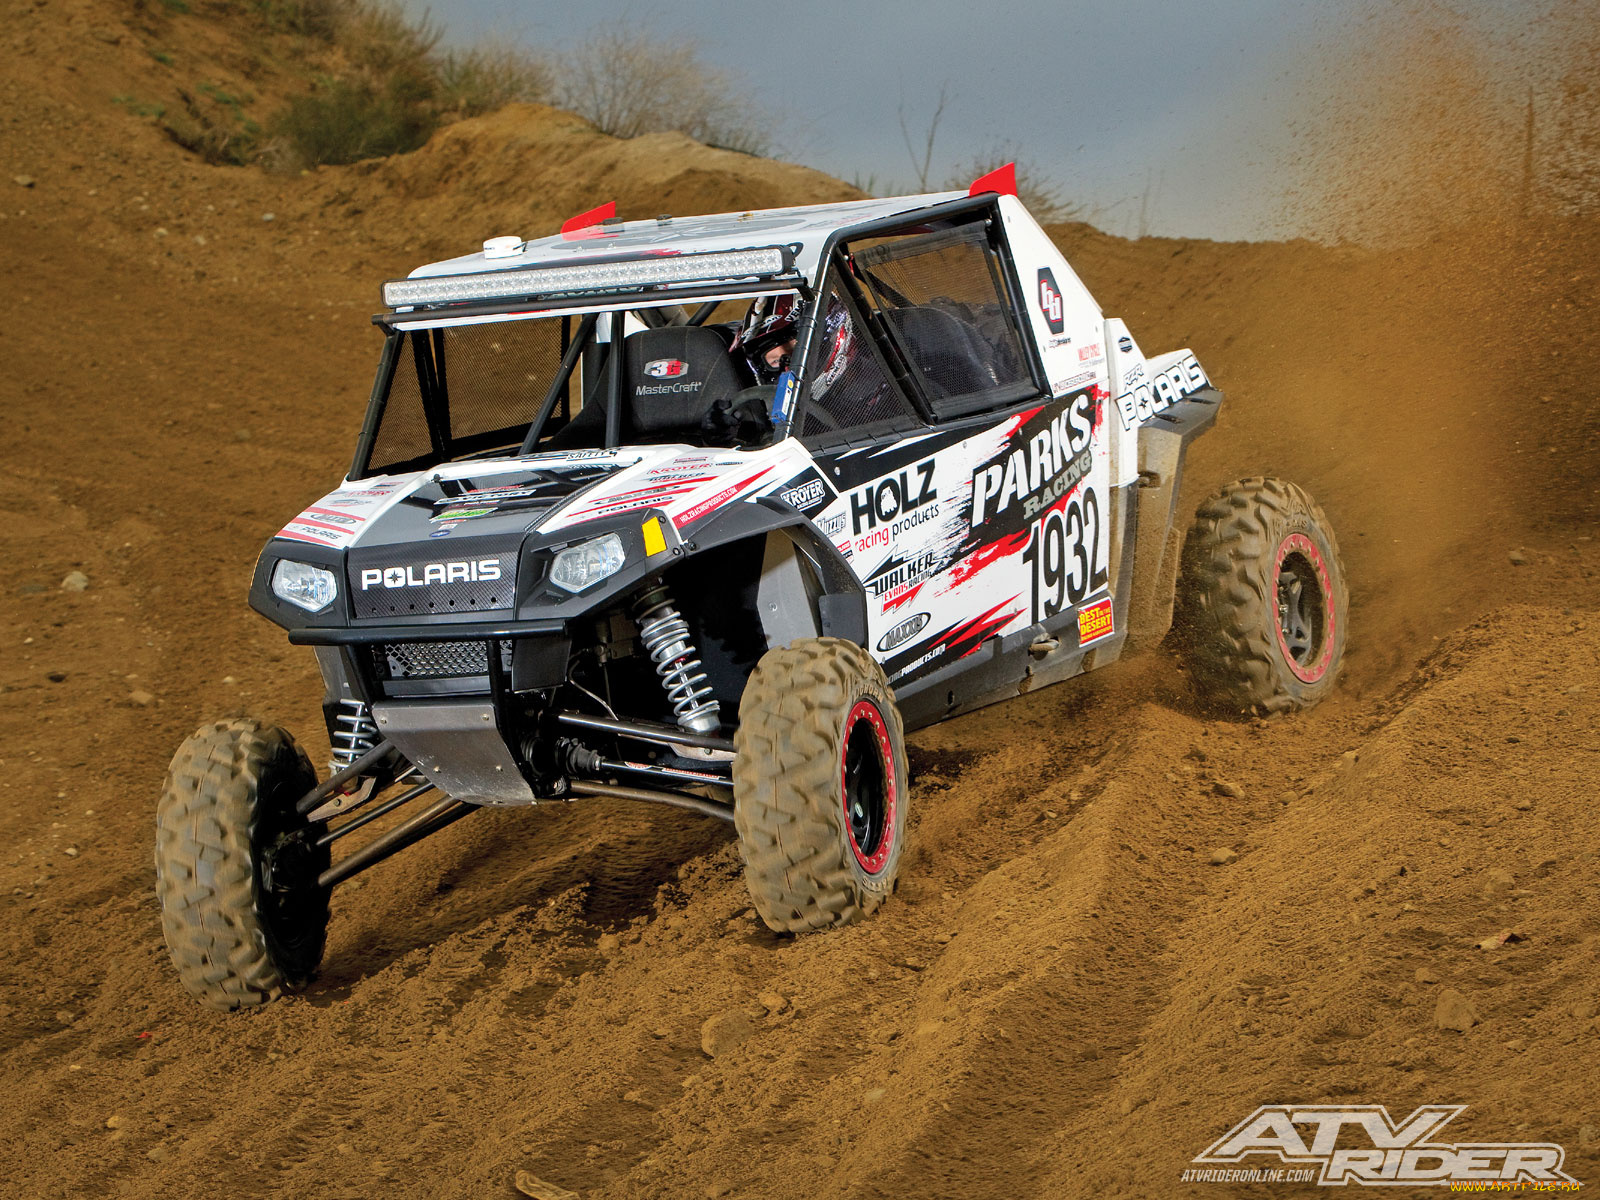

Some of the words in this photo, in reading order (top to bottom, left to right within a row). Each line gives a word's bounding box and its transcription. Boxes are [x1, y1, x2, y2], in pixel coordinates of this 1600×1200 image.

[1115, 353, 1208, 432] POLARIS
[972, 394, 1092, 528] PARKS
[598, 496, 672, 514] POLARIS
[782, 480, 824, 507] KROYER
[850, 458, 937, 537] HOLZ
[1023, 450, 1093, 520] RACING
[854, 528, 889, 552] racing
[892, 504, 940, 542] products
[361, 559, 501, 591] POLARIS
[864, 552, 937, 596] WALKER
[1023, 486, 1108, 626] 1932
[1079, 607, 1100, 625] BEST
[1080, 614, 1111, 635] DESERT
